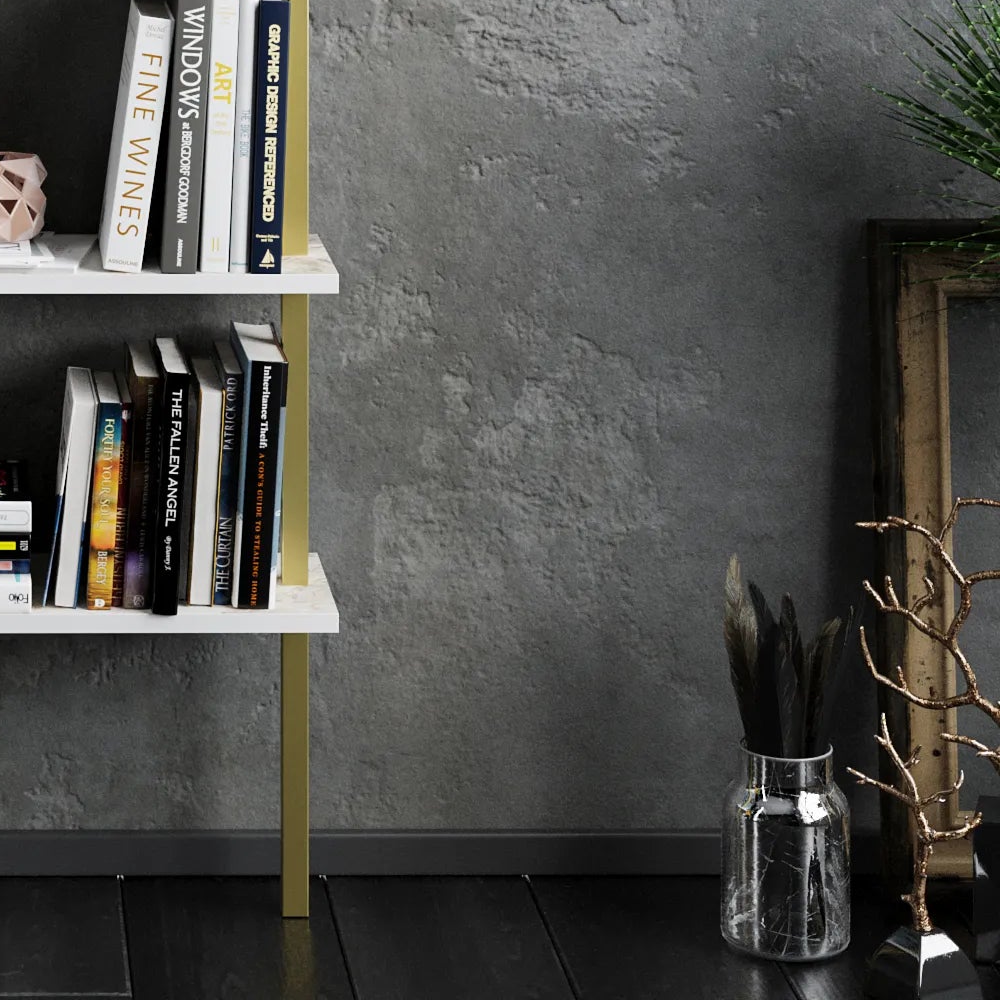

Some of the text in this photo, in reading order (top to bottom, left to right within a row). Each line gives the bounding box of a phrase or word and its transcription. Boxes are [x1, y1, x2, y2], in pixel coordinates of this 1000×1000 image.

[266, 24, 281, 83] GRAPHIC
[132, 52, 163, 121] FINE
[214, 62, 233, 104] ART
[176, 5, 206, 224] WINDOWS at BERGDORF GOODMAN
[265, 85, 279, 133] DESIGN
[117, 137, 152, 238] WINES
[262, 137, 278, 223] REFERENCED
[223, 378, 238, 450] PATRICK ORD
[261, 366, 272, 420] Inheritance
[101, 418, 115, 461] FORTIFY
[165, 389, 183, 527] THE FALLEN ANGEL
[99, 465, 113, 495] YOUR
[255, 489, 263, 517] GUIDE
[164, 535, 172, 544] By
[255, 520, 261, 532] TO
[95, 551, 108, 585] BERGEY
[215, 517, 232, 592] THE CURTAIN
[252, 535, 261, 578] STEALING
